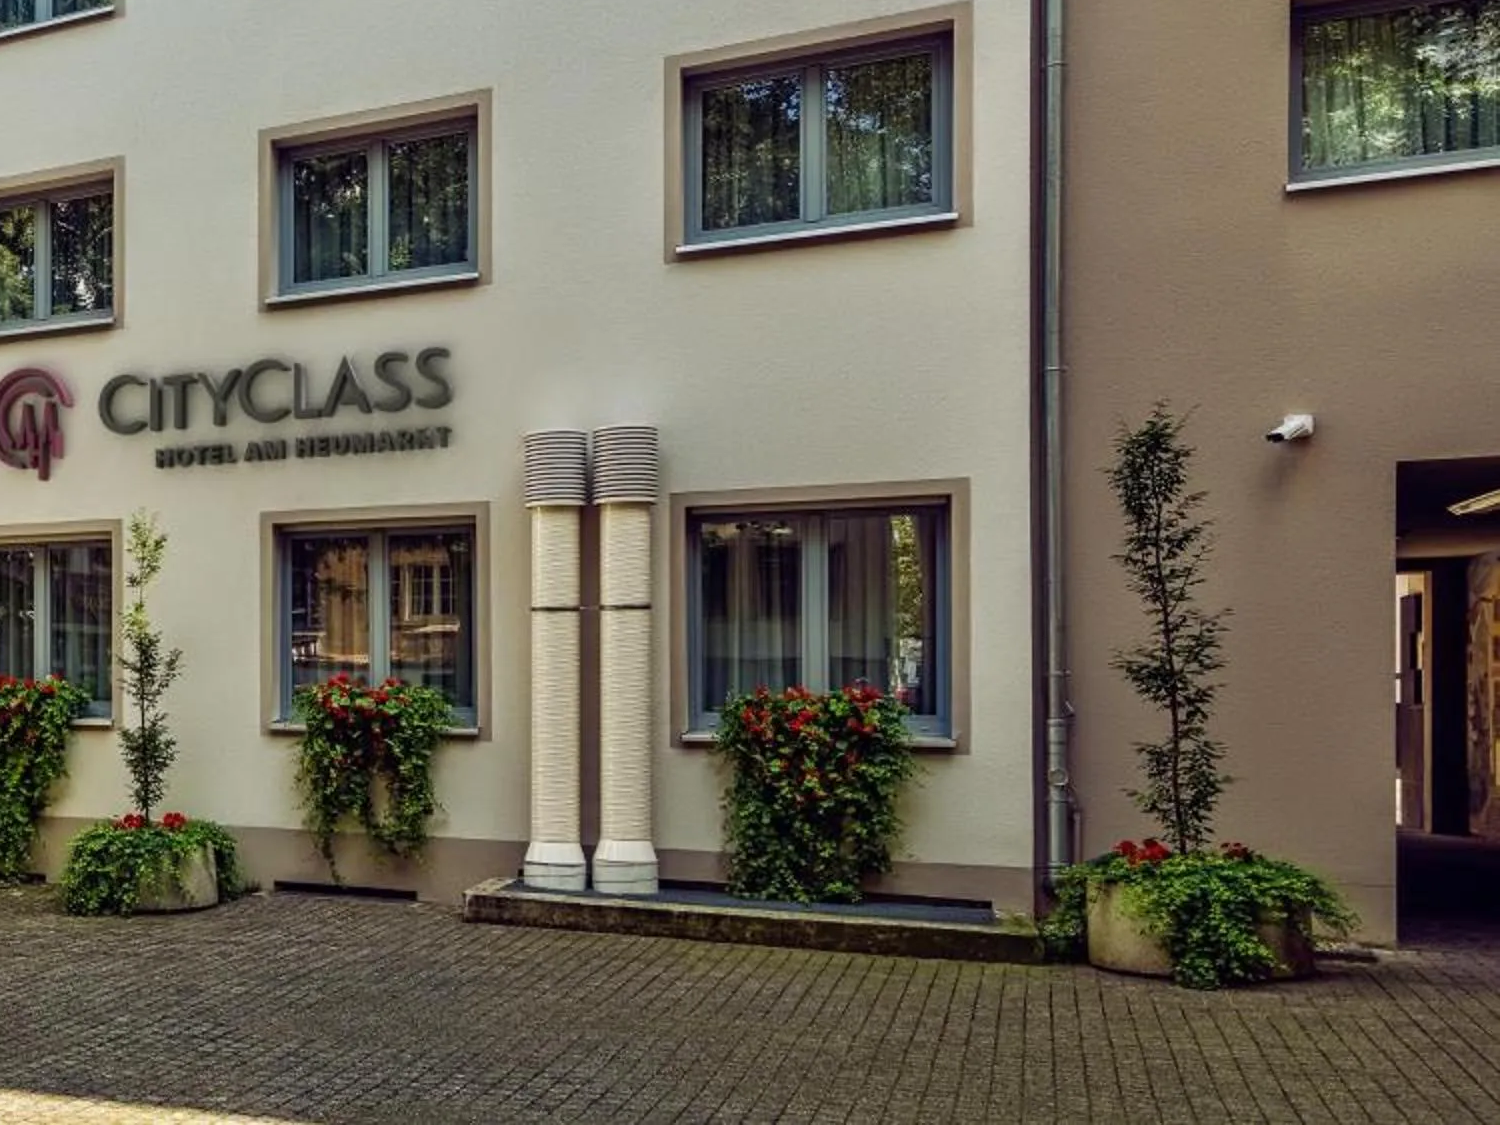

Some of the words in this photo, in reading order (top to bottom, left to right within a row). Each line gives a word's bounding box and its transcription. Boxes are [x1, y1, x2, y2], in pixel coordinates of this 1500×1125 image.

[99, 346, 453, 435] CITYCLASS
[155, 443, 238, 469] HOTEL
[244, 439, 288, 463] AM
[295, 426, 453, 459] NEUMARKT
